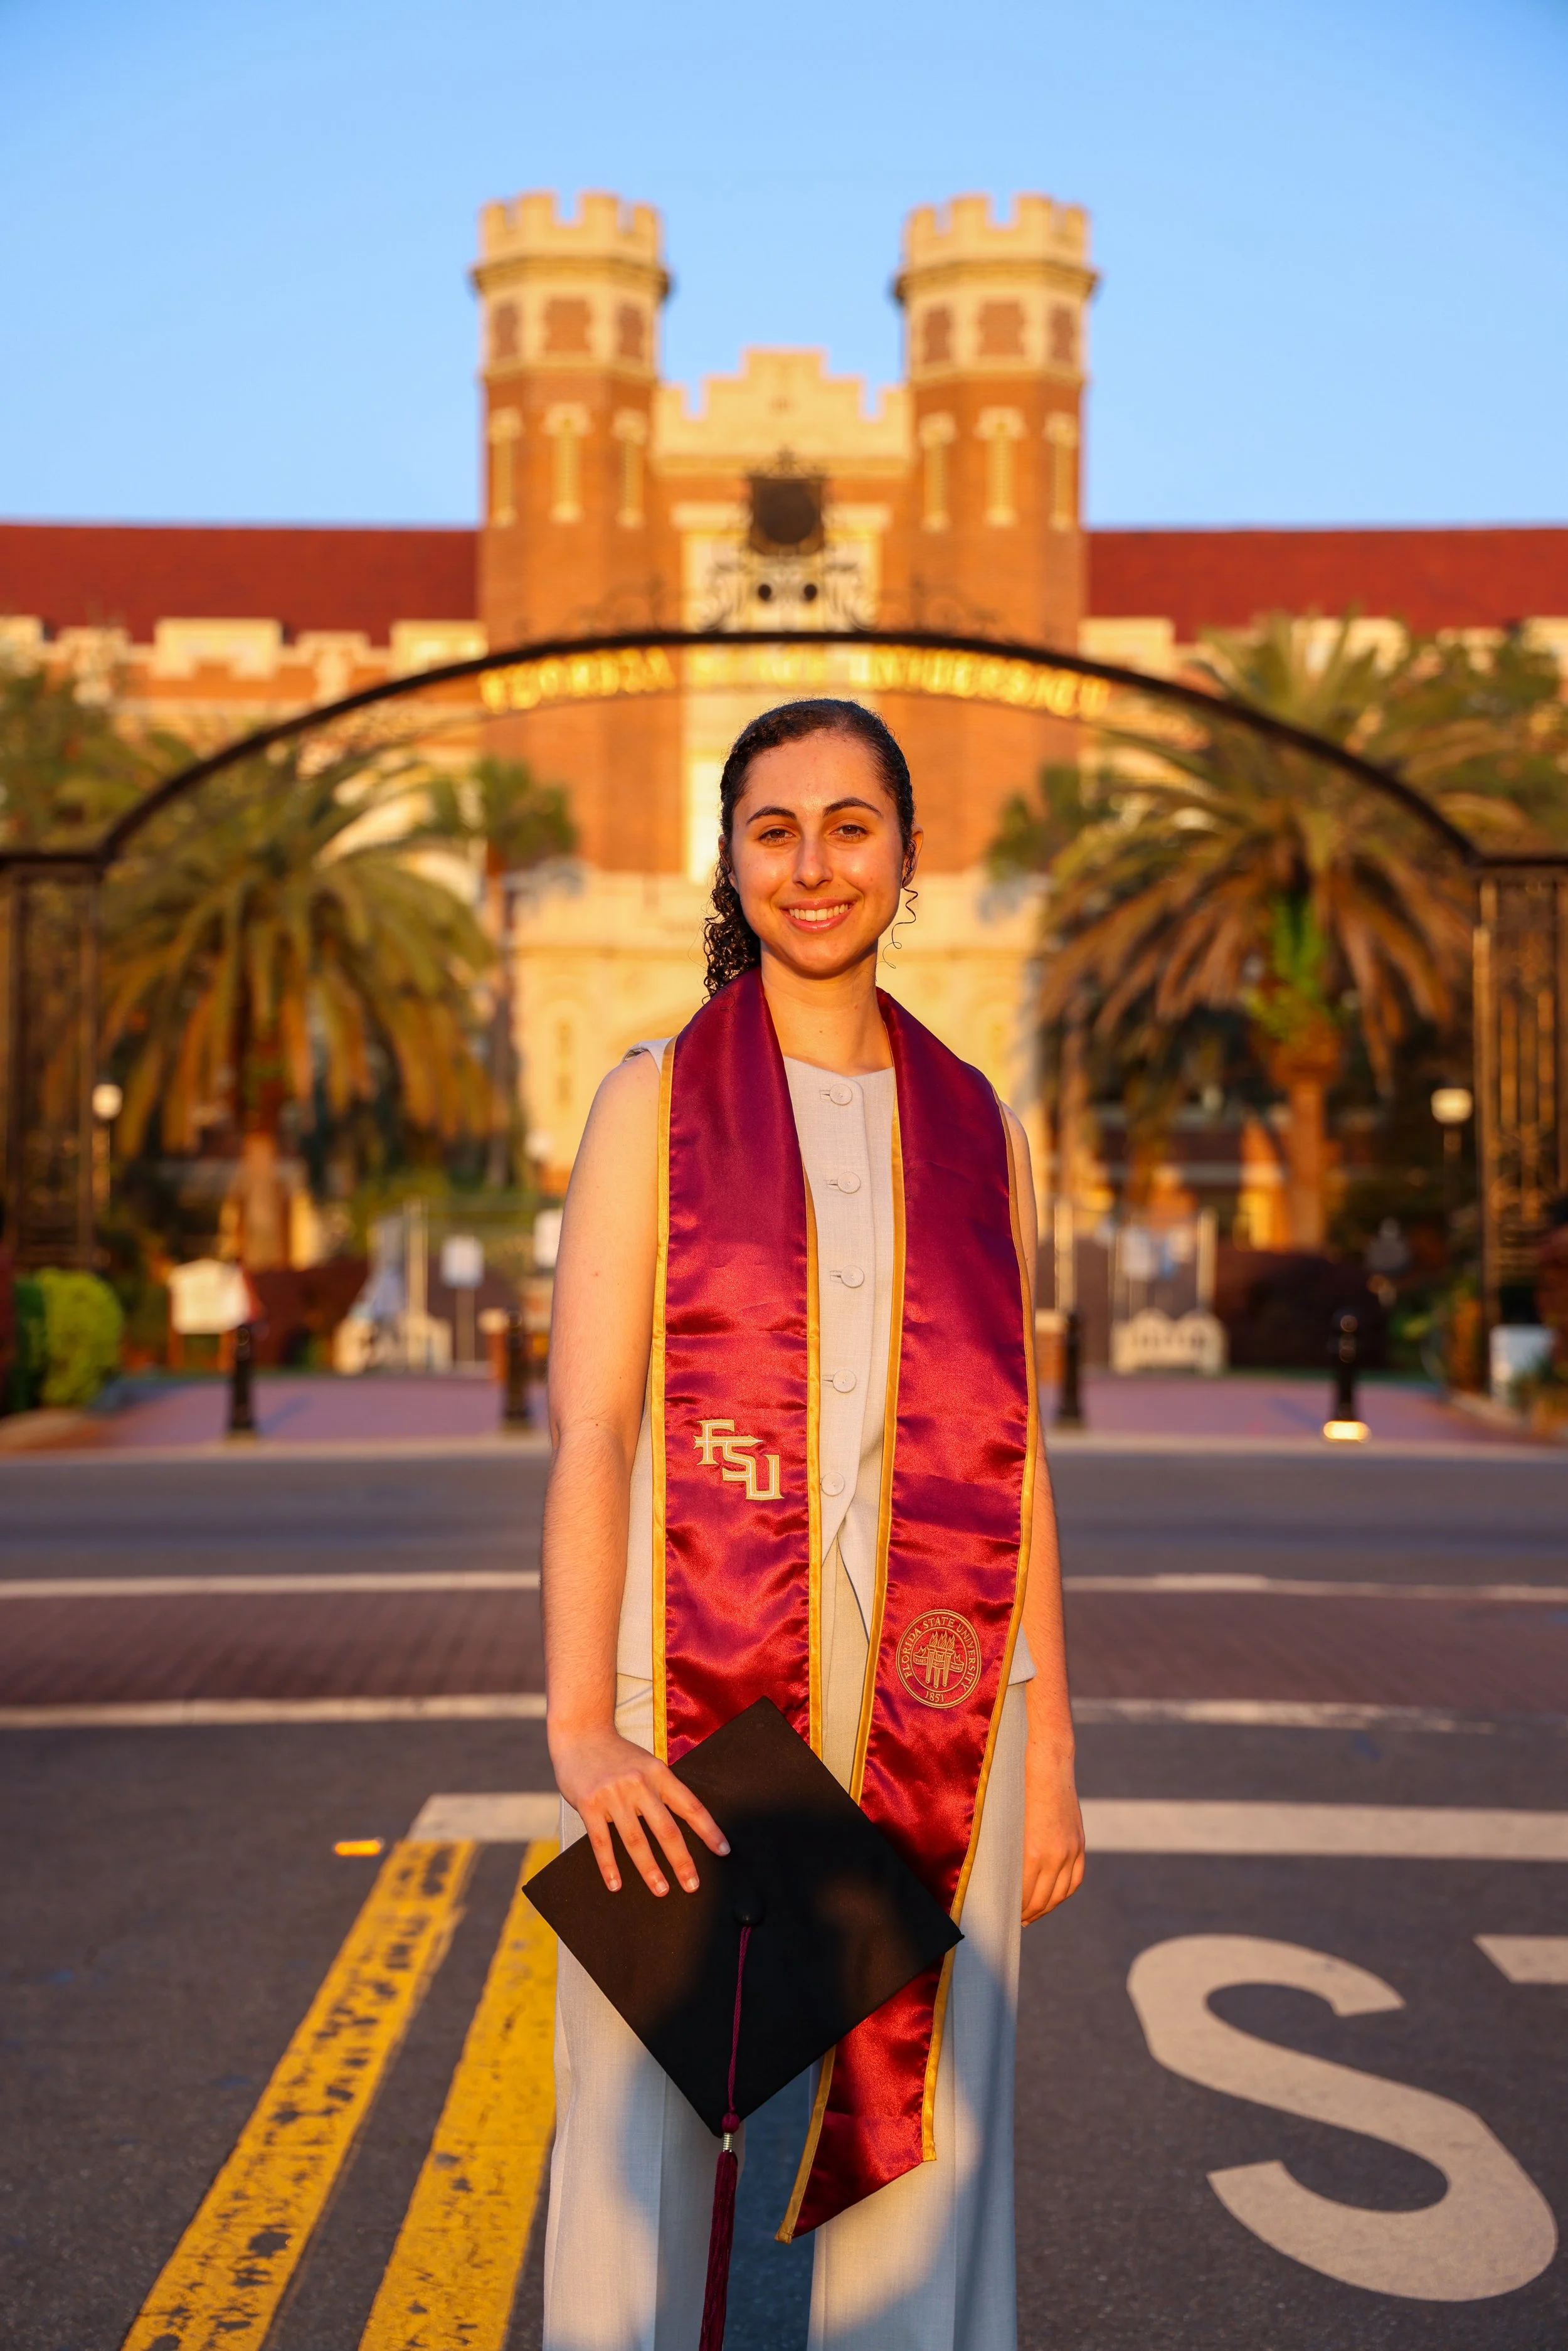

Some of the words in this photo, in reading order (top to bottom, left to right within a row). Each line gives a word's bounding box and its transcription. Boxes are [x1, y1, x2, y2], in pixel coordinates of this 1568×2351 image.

[693, 1419, 784, 1500] FSU
[901, 1628, 921, 1679] FLORIDA
[923, 1616, 955, 1629] STATE
[956, 1623, 976, 1690] UNIVERSITY
[924, 1690, 945, 1703] 1851
